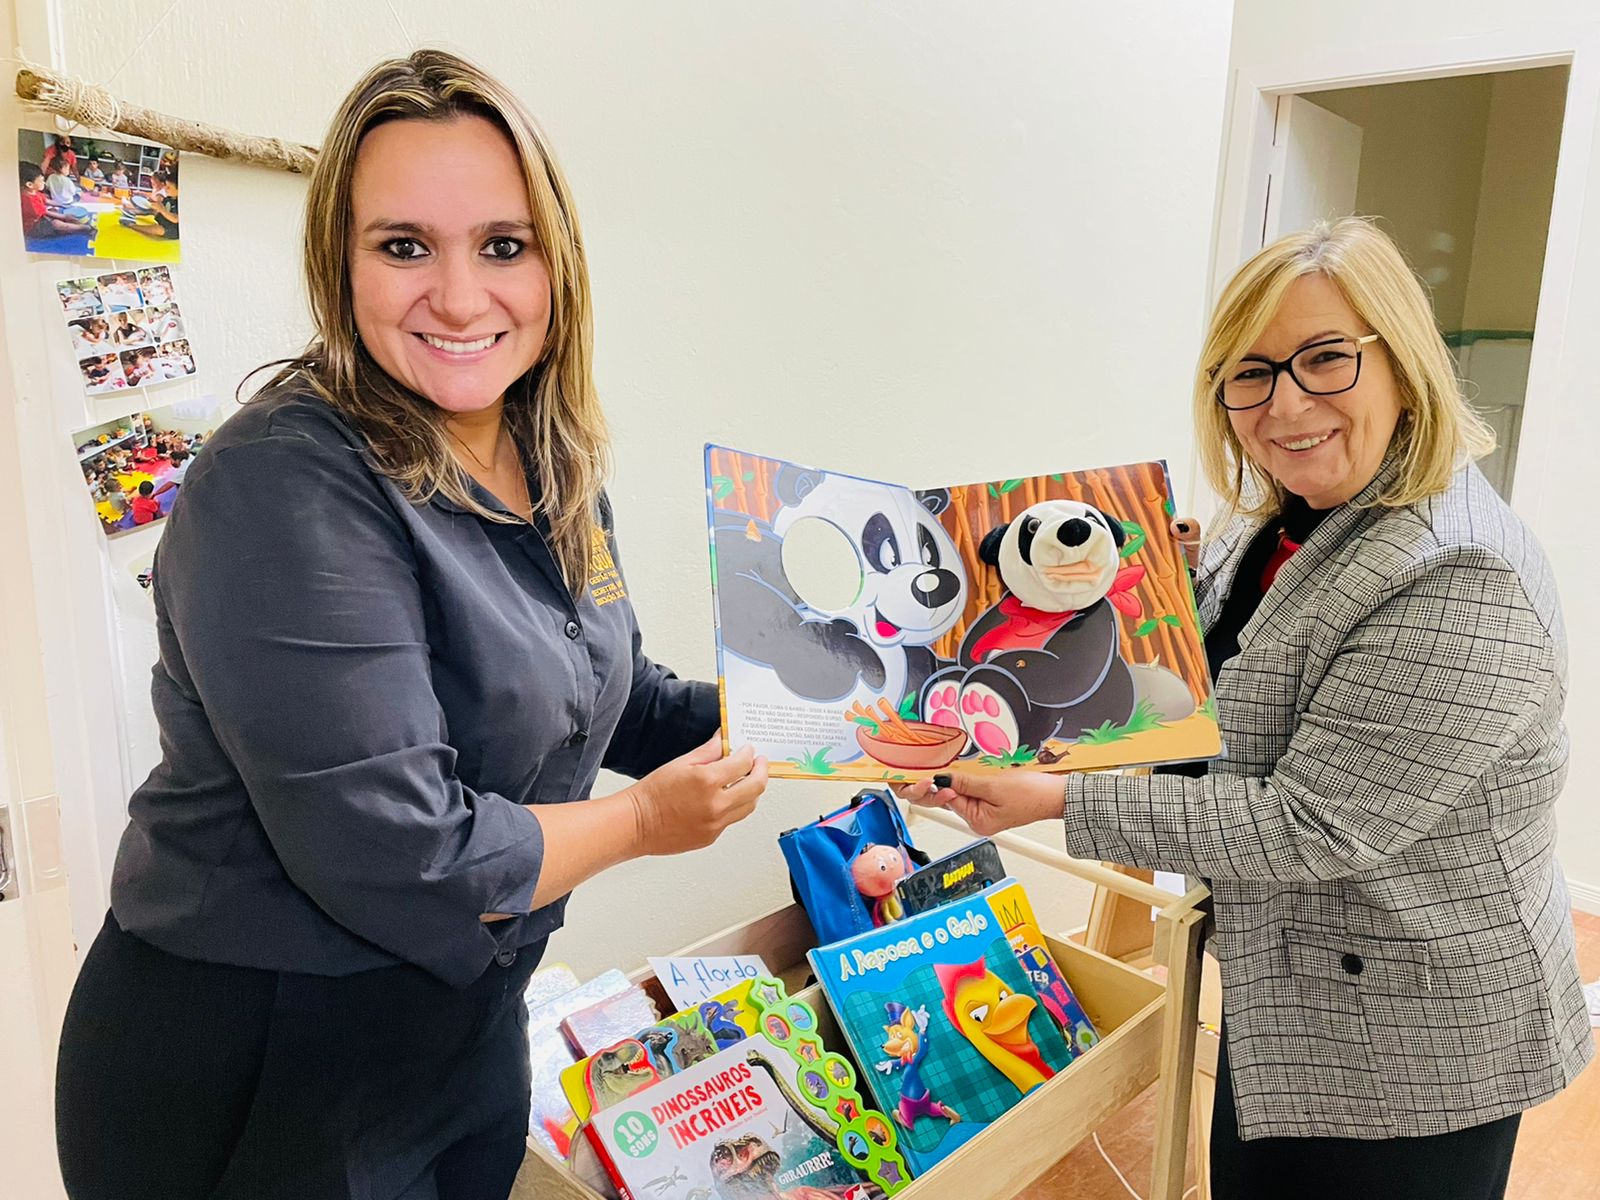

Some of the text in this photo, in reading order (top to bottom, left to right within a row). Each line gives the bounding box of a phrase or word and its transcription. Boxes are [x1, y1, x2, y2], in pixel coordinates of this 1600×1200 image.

[943, 861, 975, 889] BATMAN
[840, 910, 988, 981] A Raposa e o Galo
[670, 961, 689, 986] A
[1026, 970, 1050, 986] TER
[651, 1062, 752, 1126] DINOSSAUROS
[617, 1116, 645, 1144] 10
[667, 1085, 763, 1150] INCRÍVEIS
[629, 1130, 656, 1156] SONS
[779, 1151, 835, 1185] GRRAURRR!
